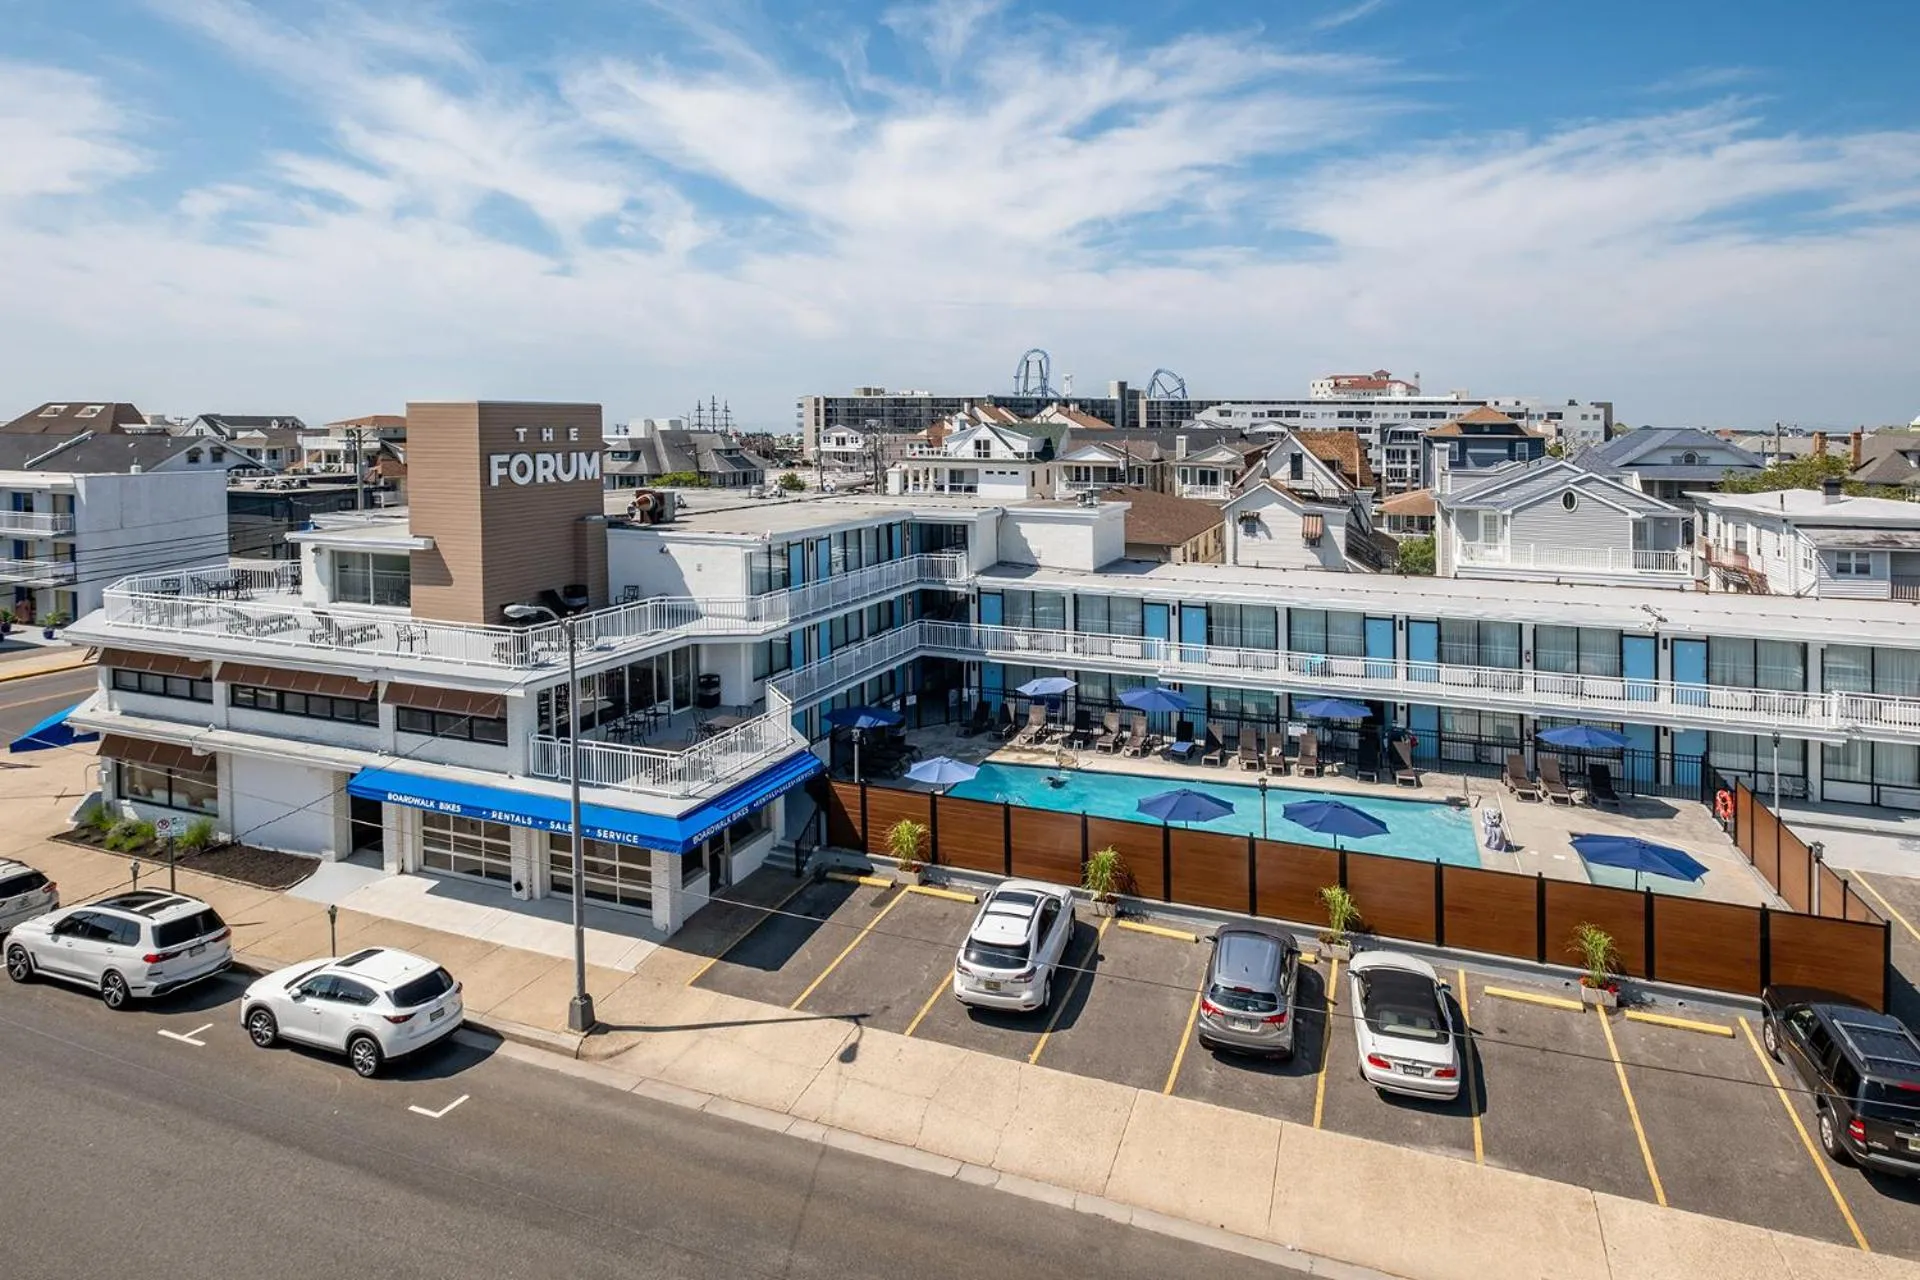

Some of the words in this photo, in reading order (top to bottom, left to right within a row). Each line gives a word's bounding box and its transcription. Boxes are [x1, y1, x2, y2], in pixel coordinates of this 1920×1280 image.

[515, 428, 579, 442] THE
[490, 452, 600, 486] FORUM
[387, 792, 435, 808] BOARDWALK
[438, 801, 462, 813] BIKES
[491, 811, 532, 825] RENTALS
[549, 820, 573, 832] SALE
[596, 828, 639, 844] SERVICE
[692, 816, 731, 845] BOARDWALK
[731, 806, 749, 821] BIKES
